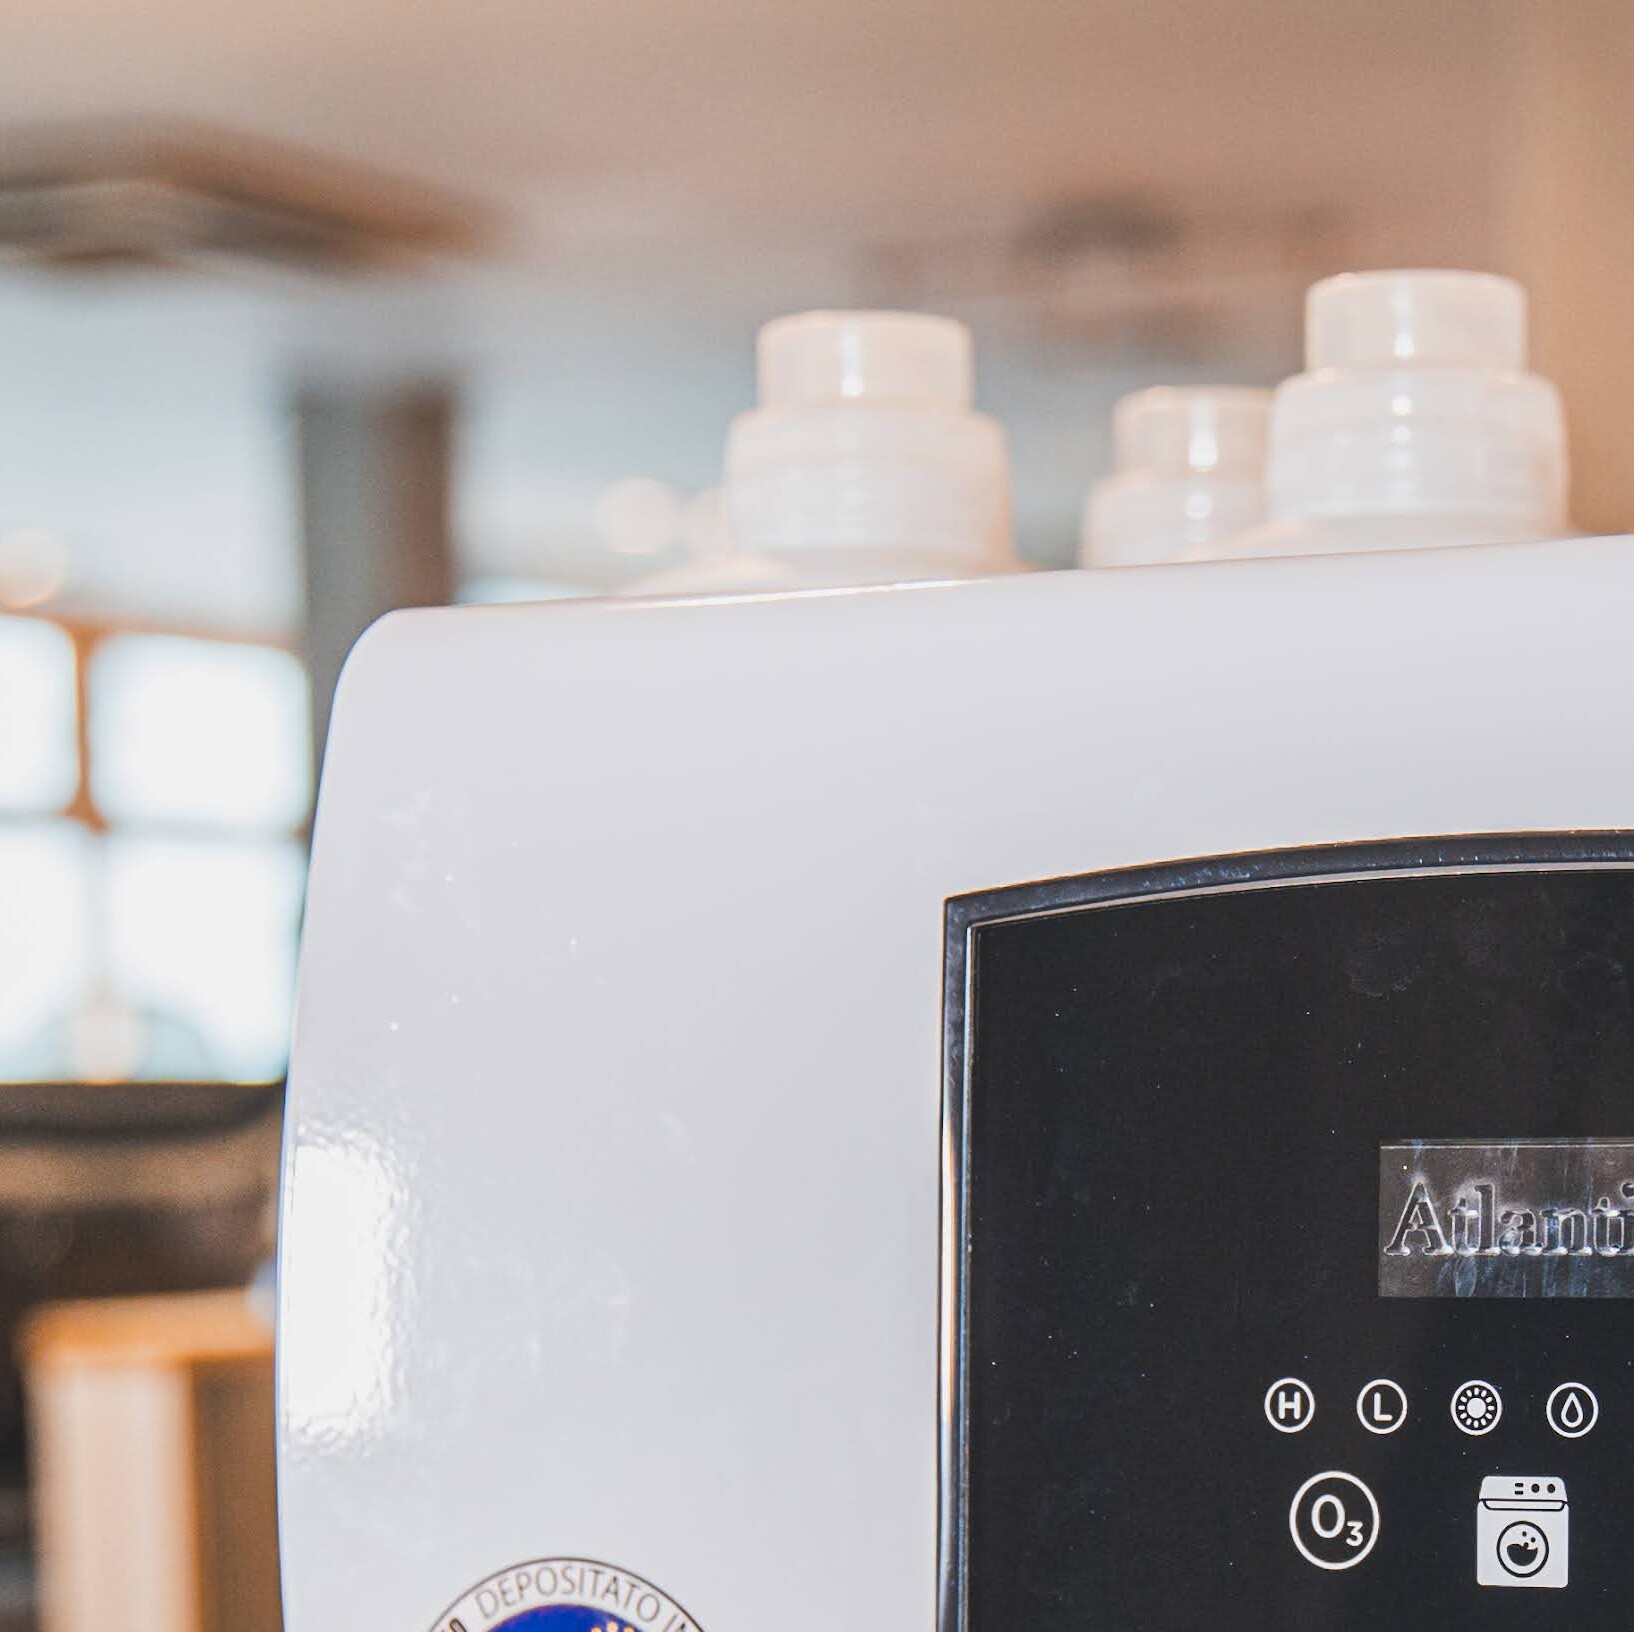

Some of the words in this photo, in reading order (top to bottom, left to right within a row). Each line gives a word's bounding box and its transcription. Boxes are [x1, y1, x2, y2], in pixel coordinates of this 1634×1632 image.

[1278, 1391, 1301, 1420] H
[1373, 1392, 1394, 1422] L
[474, 1564, 661, 1624] DEPOSITATO
